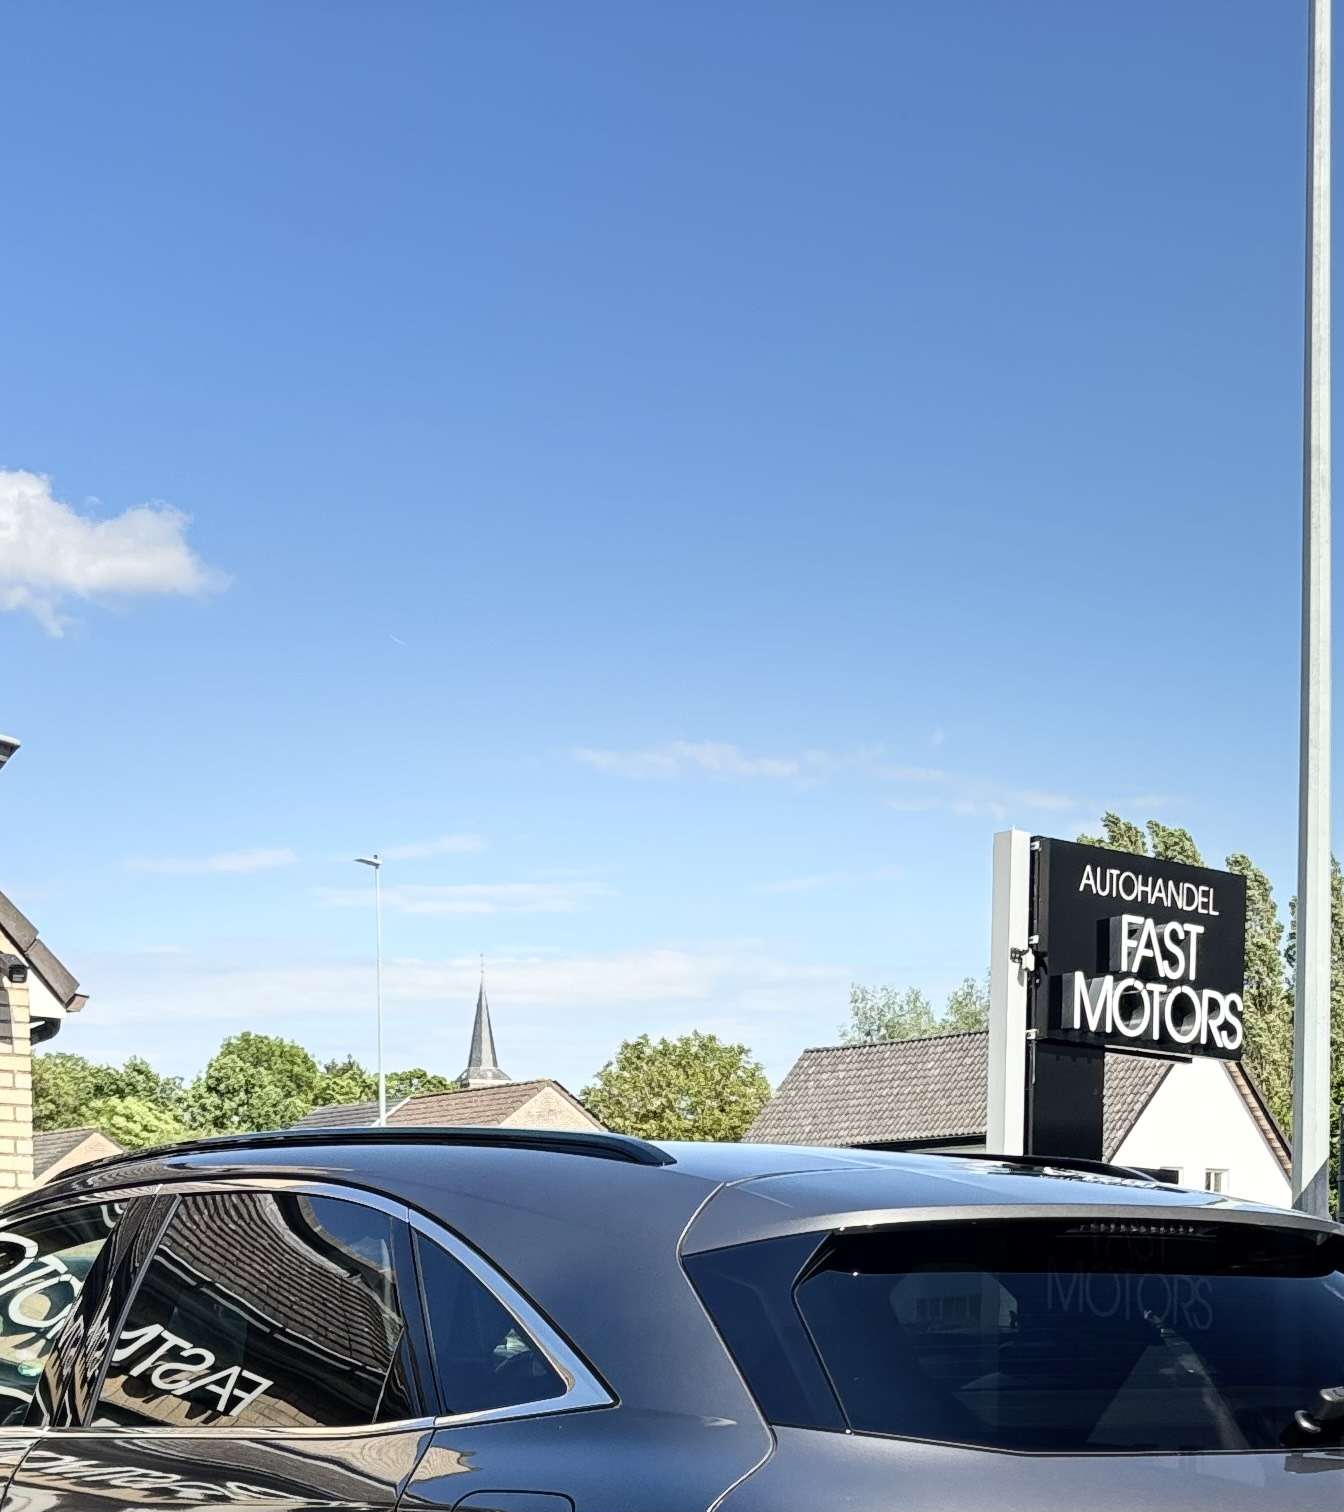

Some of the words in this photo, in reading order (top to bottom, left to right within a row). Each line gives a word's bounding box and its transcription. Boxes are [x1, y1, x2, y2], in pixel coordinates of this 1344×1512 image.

[1079, 864, 1220, 916] AUTOHANDEL
[1120, 914, 1205, 981] FAST
[1072, 970, 1244, 1051] MOTORS
